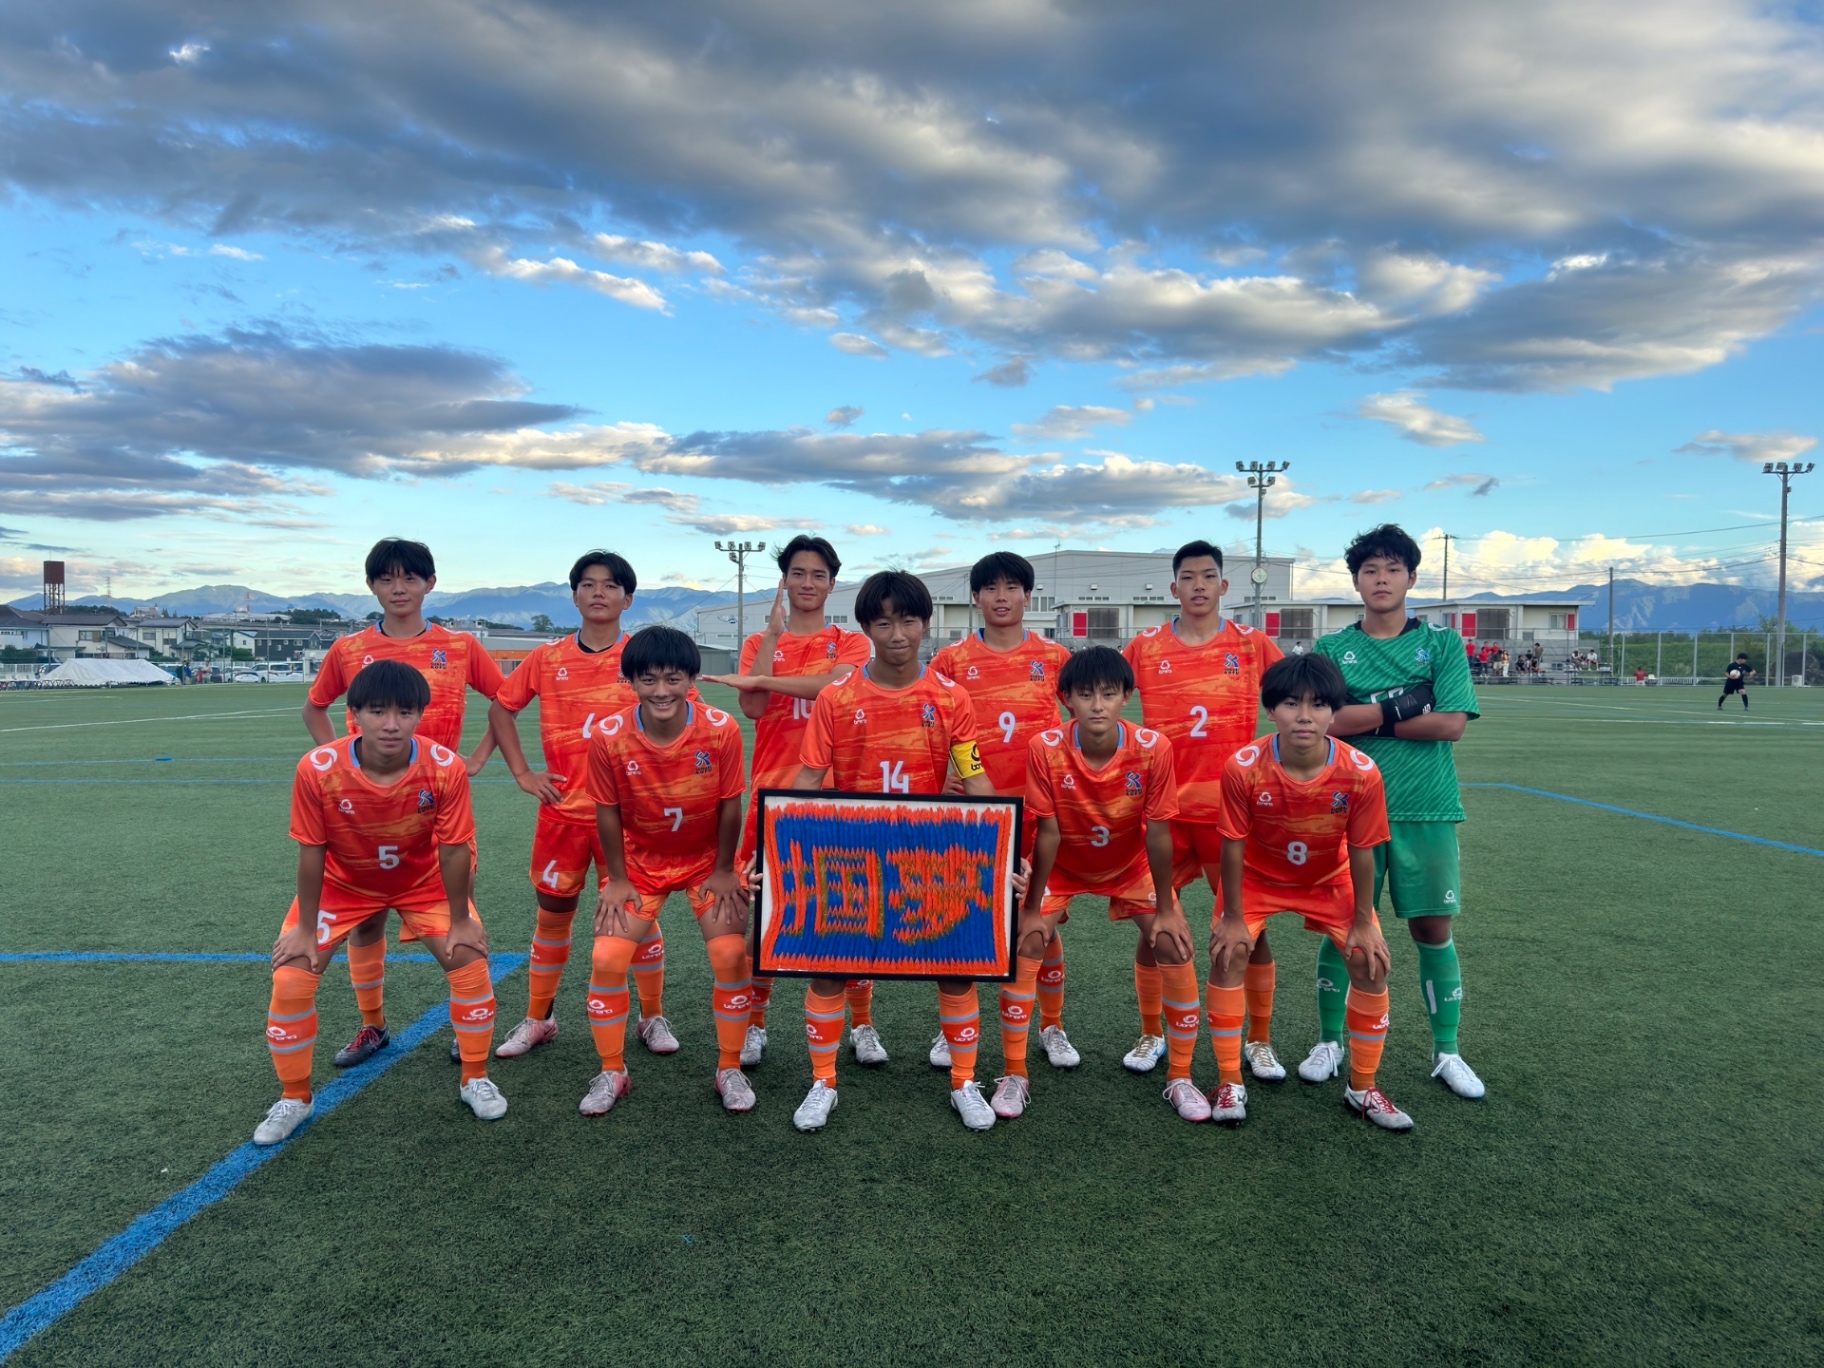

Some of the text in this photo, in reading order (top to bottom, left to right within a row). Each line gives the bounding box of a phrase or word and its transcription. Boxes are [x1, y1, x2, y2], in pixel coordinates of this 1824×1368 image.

[998, 711, 1015, 743] 9
[1189, 705, 1208, 738] 2
[879, 760, 909, 793] 14
[663, 807, 683, 832] 7
[1090, 825, 1110, 847] 3
[378, 845, 400, 870] 5
[1286, 841, 1308, 866] 8
[542, 859, 559, 889] 4
[317, 909, 337, 945] 5
